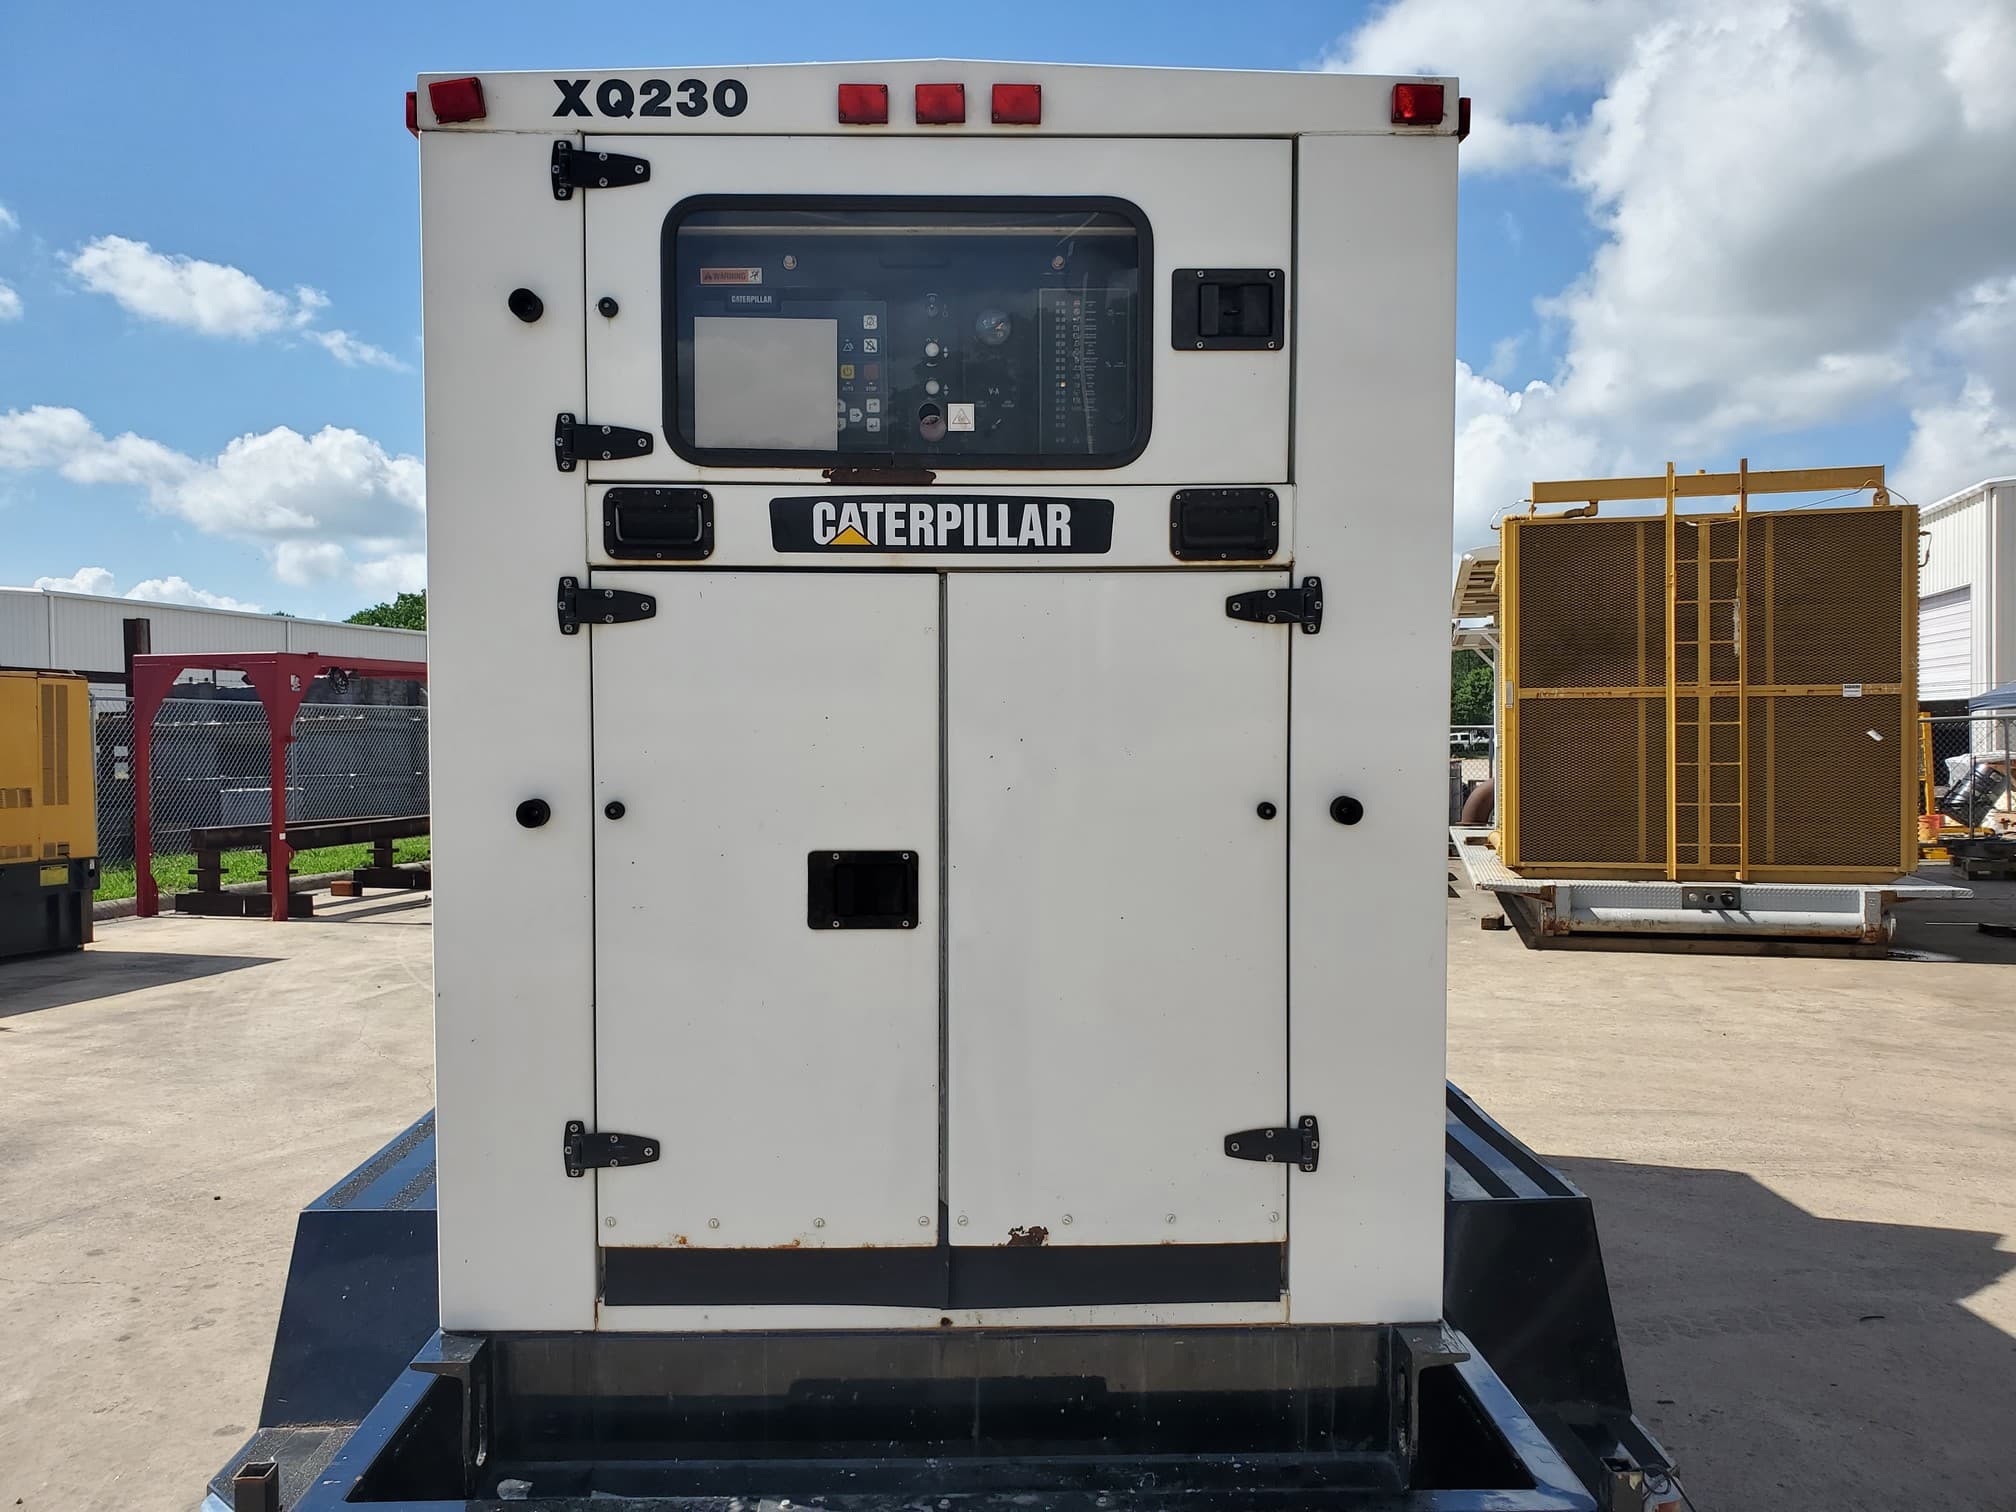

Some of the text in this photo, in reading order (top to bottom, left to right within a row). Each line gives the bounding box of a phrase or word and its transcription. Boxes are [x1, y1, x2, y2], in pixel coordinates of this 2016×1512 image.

[553, 79, 748, 118] XQ230
[713, 271, 746, 280] WARNING
[731, 295, 772, 303] CATERPILLAR
[812, 501, 1071, 547] CATERPILLAR
